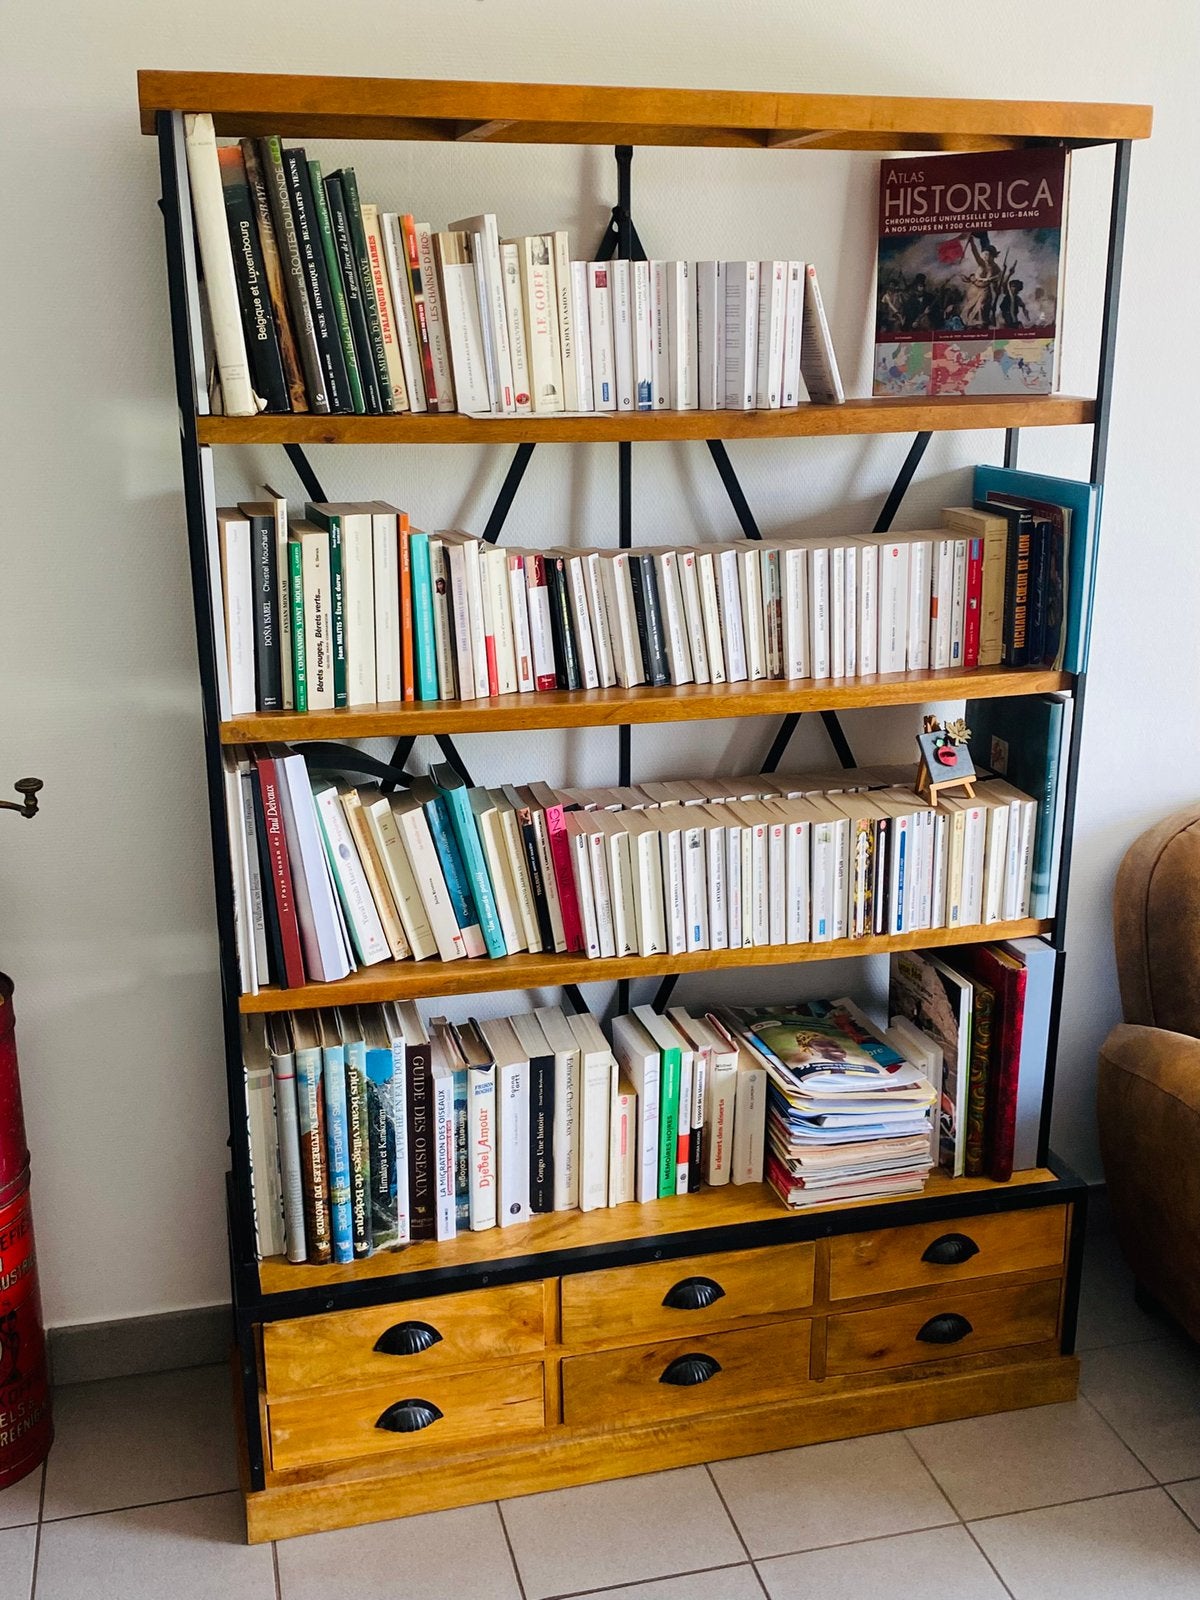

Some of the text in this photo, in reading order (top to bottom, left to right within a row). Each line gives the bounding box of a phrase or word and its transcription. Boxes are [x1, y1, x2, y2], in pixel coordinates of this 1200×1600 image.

[288, 157, 302, 188] VIENNE
[254, 180, 273, 234] HESBAYE
[294, 191, 312, 241] BEAUX-ARTS
[314, 170, 331, 235] Claude Dufresne
[885, 178, 1054, 216] HISTORICA
[885, 216, 937, 225] CHRONOLOGIE
[939, 213, 987, 222] UNIVERSELLE
[1002, 210, 1040, 218] BIG-BANG
[274, 166, 301, 275] ROUTES DU MONDE
[909, 224, 931, 232] JOURS
[933, 223, 943, 231] EN
[965, 221, 992, 229] CARTES
[303, 243, 315, 259] DES
[334, 210, 358, 300] le grand livre de la Meuse
[238, 220, 268, 341] Belgique et Luxembourg
[297, 276, 306, 288] les
[299, 288, 309, 302] sur
[306, 262, 324, 310] HISTORIQUE
[368, 235, 393, 345] LE PALANQUIN DES LARMES
[420, 231, 440, 322] LES CHAÎNES D'ÉROS
[336, 292, 351, 331] Viennoise
[360, 257, 390, 386] LE MIROIR DE LA HESBAYE
[533, 270, 547, 335] LE GOFF
[561, 286, 572, 359] MES DIX ÉVASIONS
[260, 528, 272, 592] Christel Mouchard
[1017, 558, 1029, 570] DE
[1018, 533, 1031, 557] LION
[281, 592, 289, 609] MON
[293, 574, 303, 604] MOURIR
[263, 600, 273, 646] DOÑA ISABEL
[294, 607, 304, 626] VONT
[313, 613, 323, 639] Bérets
[333, 573, 344, 660] Jean MILITIS Être et durer
[1013, 605, 1027, 649] RICHARD
[295, 628, 305, 671] COMMANDOS
[313, 640, 324, 668] rouges,
[314, 669, 324, 693] Bérets
[264, 783, 281, 834] Paul Delvaux
[272, 836, 290, 913] Le Pays Mosan de
[345, 861, 370, 925] Yuval Noah Harari
[474, 871, 496, 932] Un monde positif
[394, 1041, 403, 1075] DOUCE
[394, 1077, 404, 1097] EAU
[395, 1099, 404, 1112] EN
[377, 1108, 388, 1149] Karakoram
[412, 1055, 427, 1199] GUIDE DES OISEAUX
[716, 1098, 726, 1126] déserts
[716, 1126, 724, 1138] des
[306, 1056, 326, 1236] MERVEILLES NATURELLES DU MONDE
[333, 1120, 345, 1174] NATURELLES
[348, 1049, 367, 1237] Les plus beaux villages de Belgique
[396, 1146, 405, 1160] LA
[437, 1089, 448, 1197] LA MIGRATION DES OISEAUX
[457, 1109, 467, 1187] éléments d'écologie
[476, 1108, 495, 1188] Djebel Amour
[536, 1111, 547, 1183] Congo. Une histoire
[664, 1115, 674, 1180] MÉMOIRES NOIRES
[715, 1139, 724, 1163] désert
[336, 1177, 346, 1190] DE
[378, 1158, 389, 1194] Himalaya
